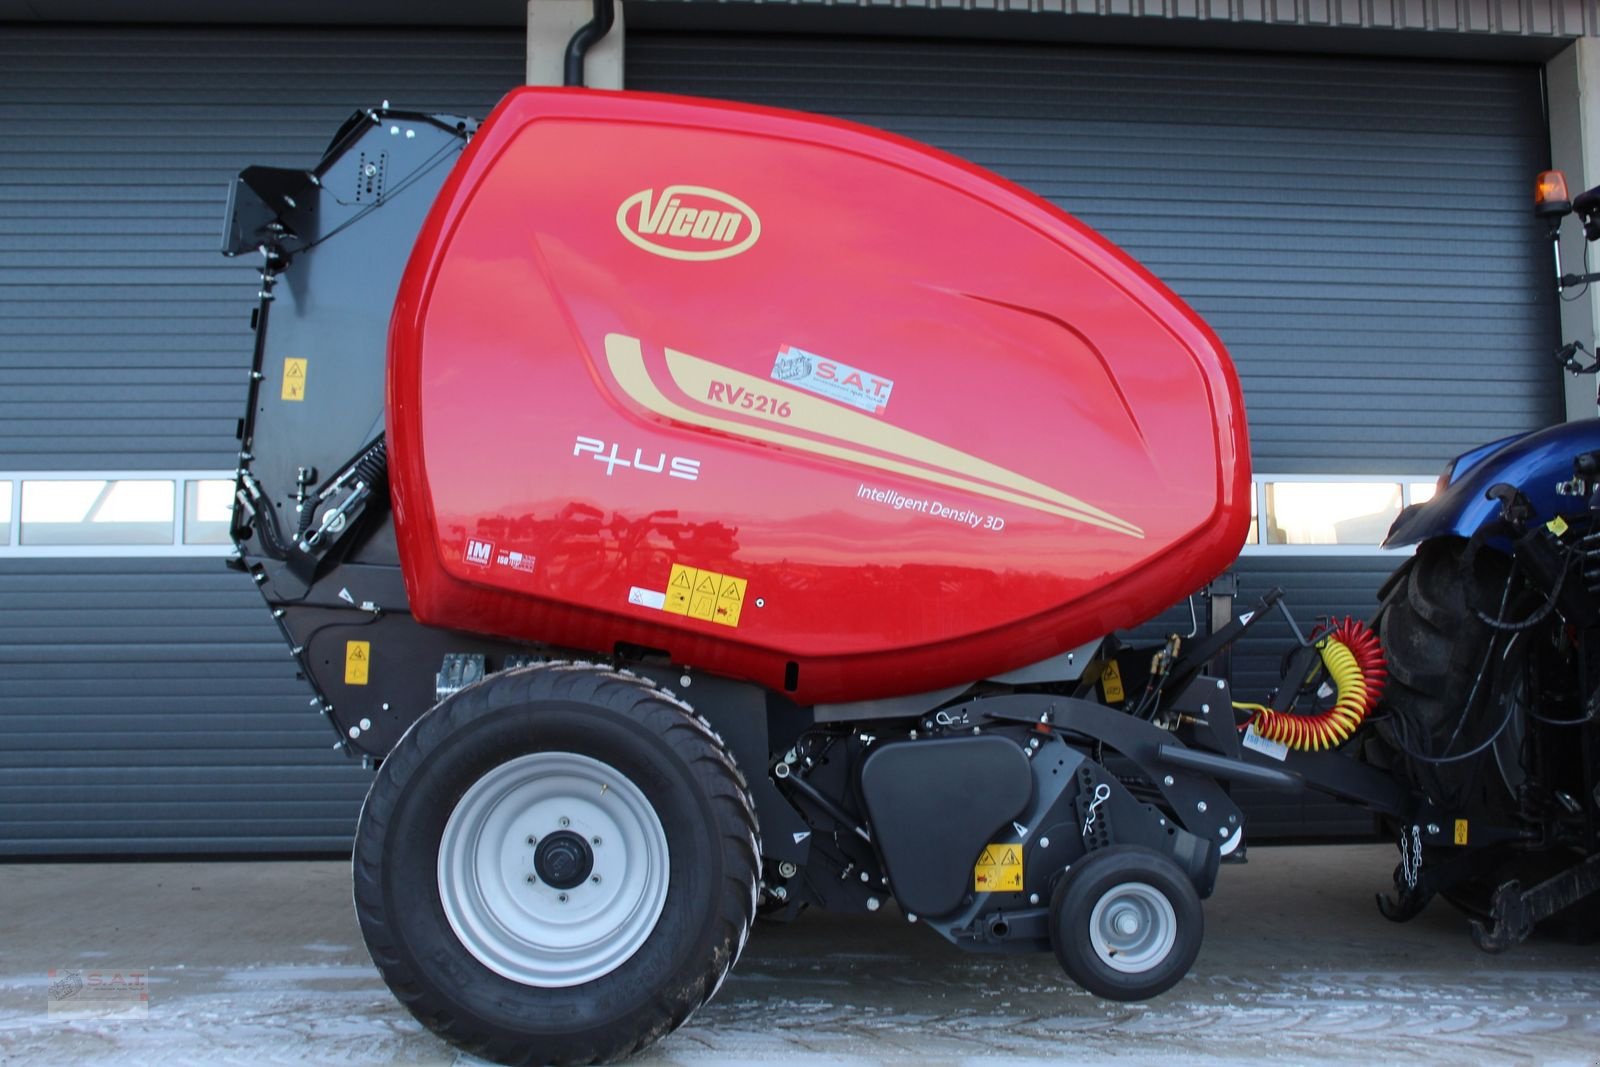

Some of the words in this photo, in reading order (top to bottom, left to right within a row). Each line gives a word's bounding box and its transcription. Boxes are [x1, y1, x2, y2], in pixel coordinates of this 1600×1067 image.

[638, 188, 742, 242] Vicon
[707, 380, 792, 418] RV5216
[857, 484, 928, 512] Intelligent
[929, 502, 983, 528] Density
[983, 515, 1005, 531] 3D
